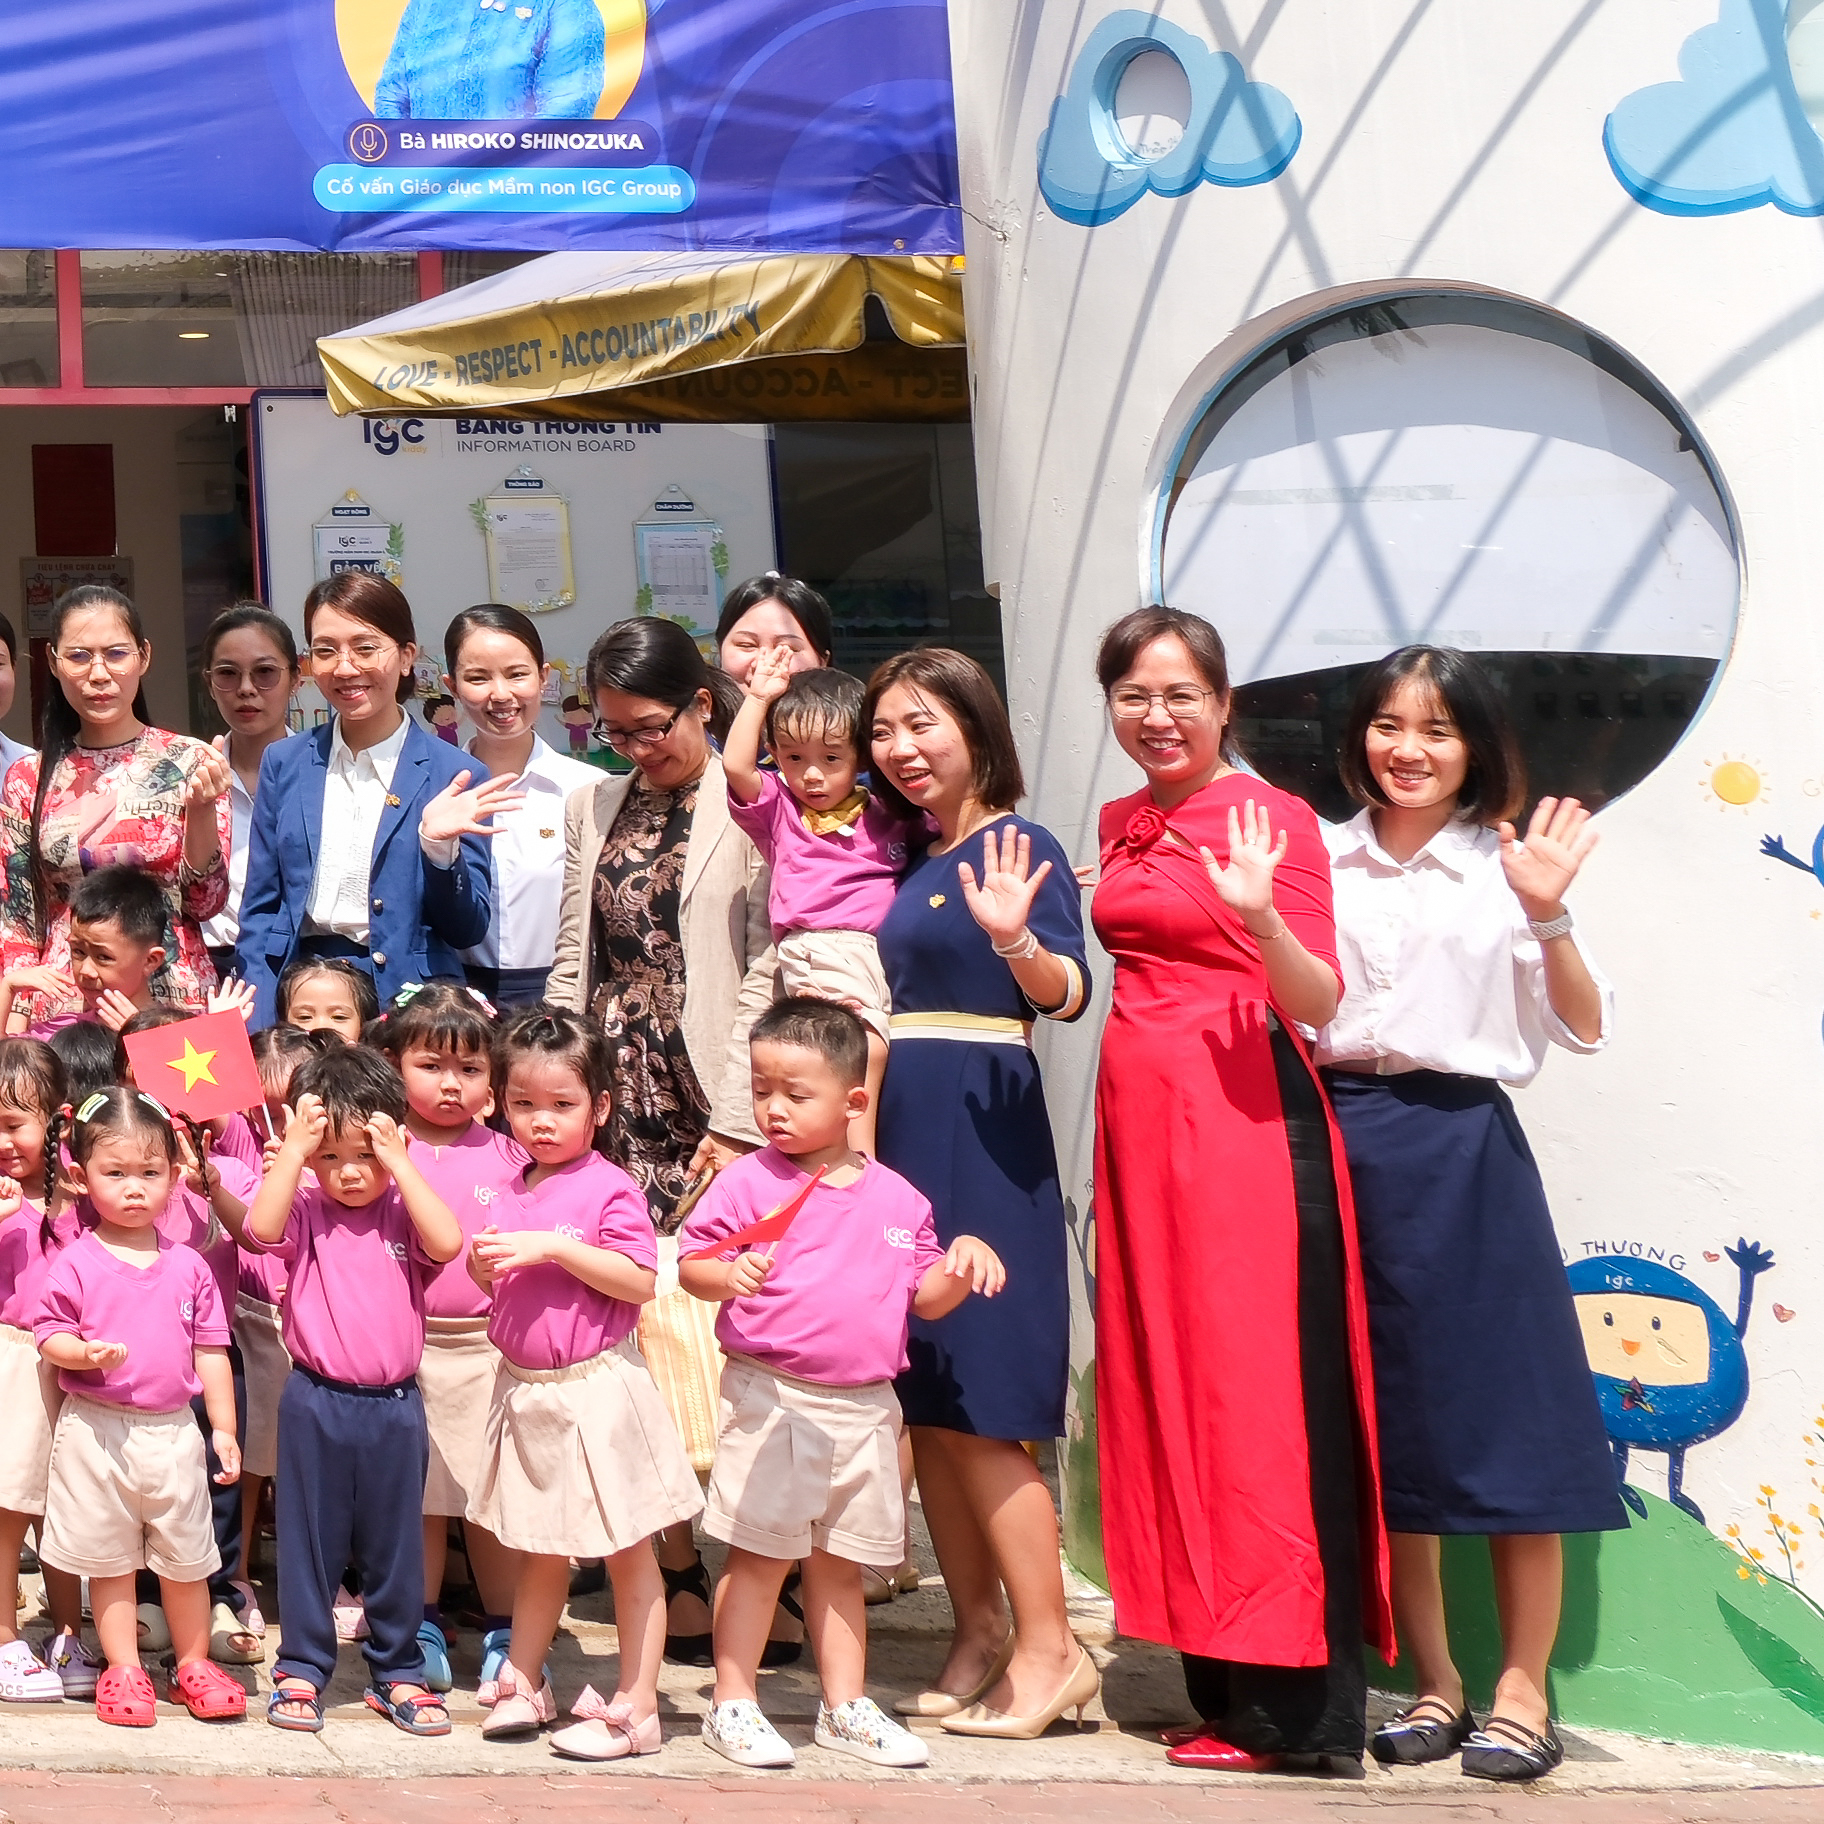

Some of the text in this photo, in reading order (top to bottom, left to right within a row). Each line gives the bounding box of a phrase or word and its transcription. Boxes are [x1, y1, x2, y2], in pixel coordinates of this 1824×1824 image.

[399, 133, 645, 151] Bà HIROKO SHINOZUKA
[327, 175, 681, 199] Cố vấn Giáo dục Mầm non IGC Group
[374, 360, 439, 392] LOVE
[455, 339, 542, 386] RESPECT
[561, 300, 763, 371] ACCOUNTABILITY
[457, 439, 636, 453] INFORMATION BOARD
[1580, 1239, 1687, 1271] THƯƠNG
